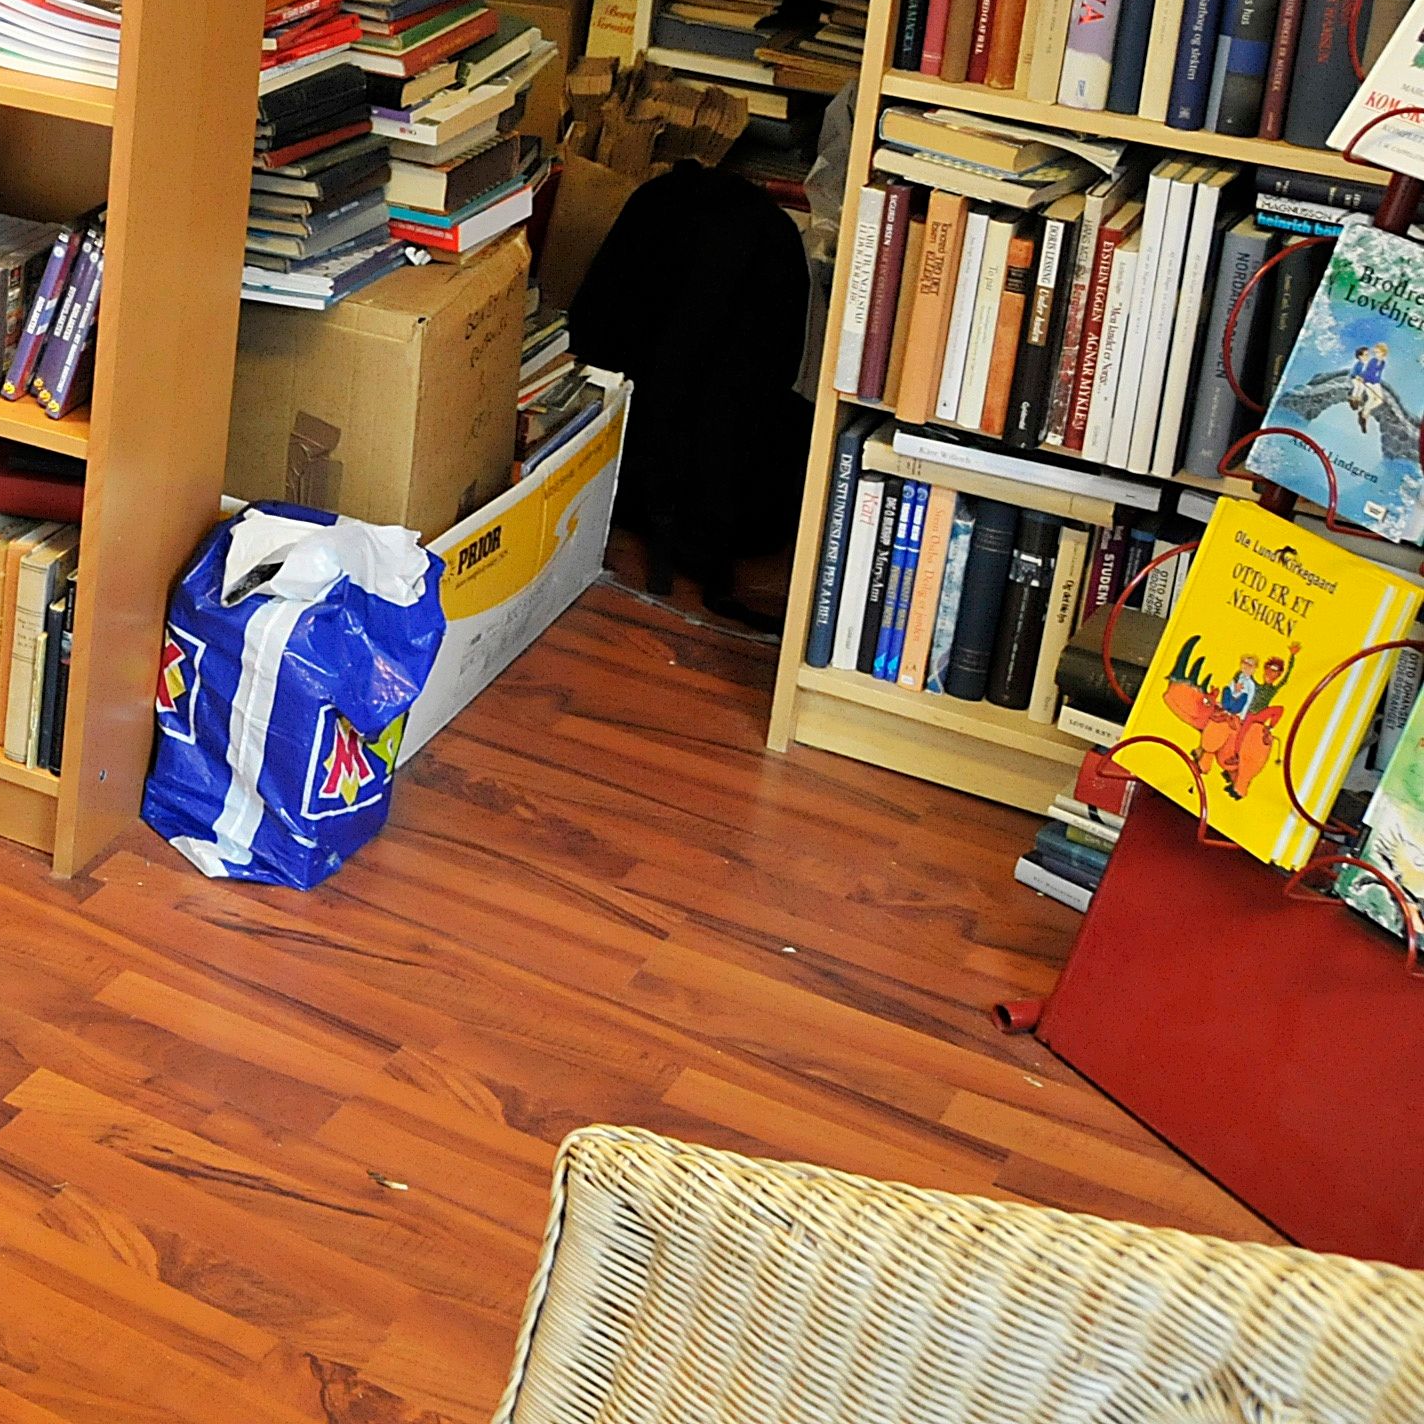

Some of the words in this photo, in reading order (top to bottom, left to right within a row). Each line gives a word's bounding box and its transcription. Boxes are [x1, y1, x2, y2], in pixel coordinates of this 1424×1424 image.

[1240, 8, 1252, 25] hus
[1045, 224, 1059, 249] DORIS
[1039, 249, 1055, 283] LESSING
[1095, 240, 1114, 283] EYSTEIN
[1034, 288, 1049, 313] Under
[1089, 284, 1105, 323] EGGEN
[1080, 332, 1098, 376] AGNAR
[1073, 377, 1091, 420] MYKLE
[838, 453, 853, 480] DEN
[826, 481, 848, 562] STUNDESLØSE
[456, 525, 503, 576] PRIOR
[823, 564, 836, 585] PER
[1094, 553, 1115, 605] STUDENT
[1229, 560, 1269, 593] OTTO
[1267, 580, 1293, 605] ER
[1290, 592, 1314, 618] ET
[815, 587, 832, 626] AABEL
[1226, 587, 1298, 638] NESHORN
